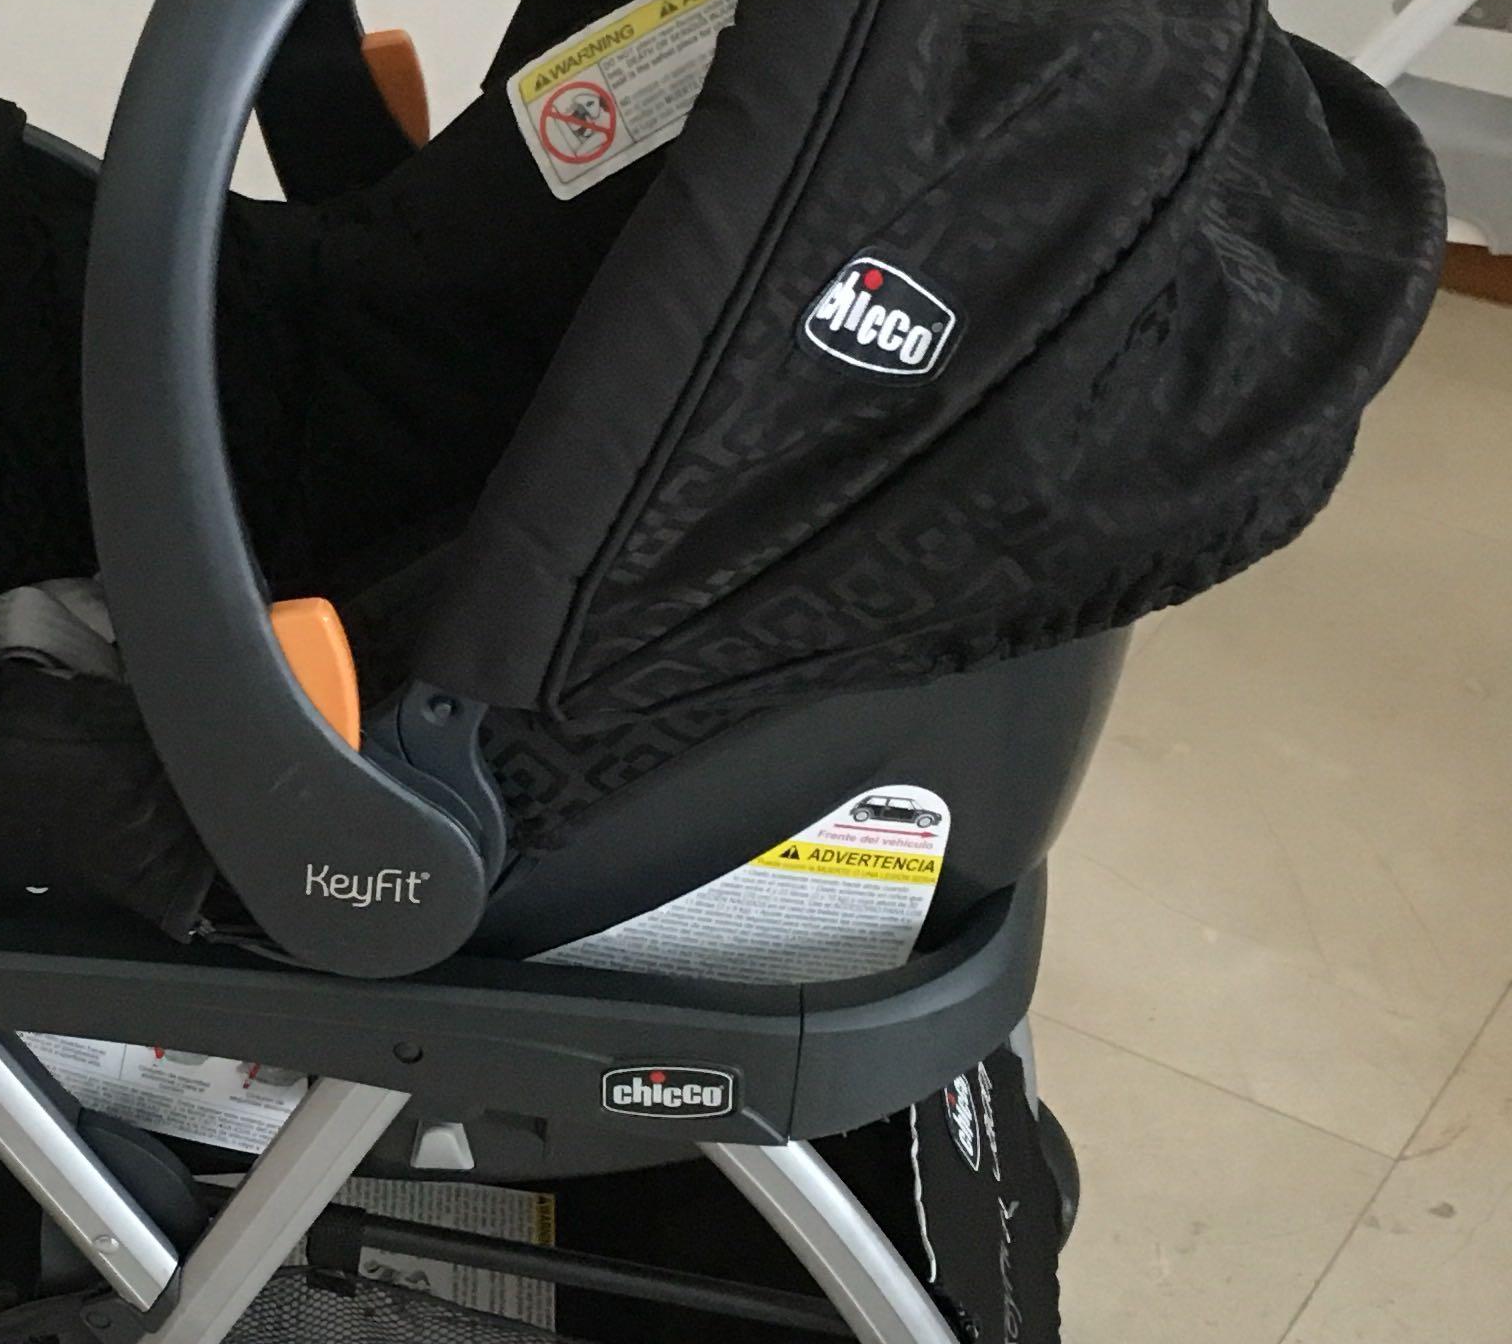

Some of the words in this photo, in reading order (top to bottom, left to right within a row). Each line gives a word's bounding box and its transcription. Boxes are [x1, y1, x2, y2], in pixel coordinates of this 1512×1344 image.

[548, 24, 635, 79] WARNING
[815, 268, 933, 365] chicco
[817, 829, 857, 842] Frente
[859, 834, 879, 844] del
[808, 847, 935, 873] ADVERTENCIA
[305, 863, 422, 907] KeyFit
[613, 1070, 722, 1108] chicco
